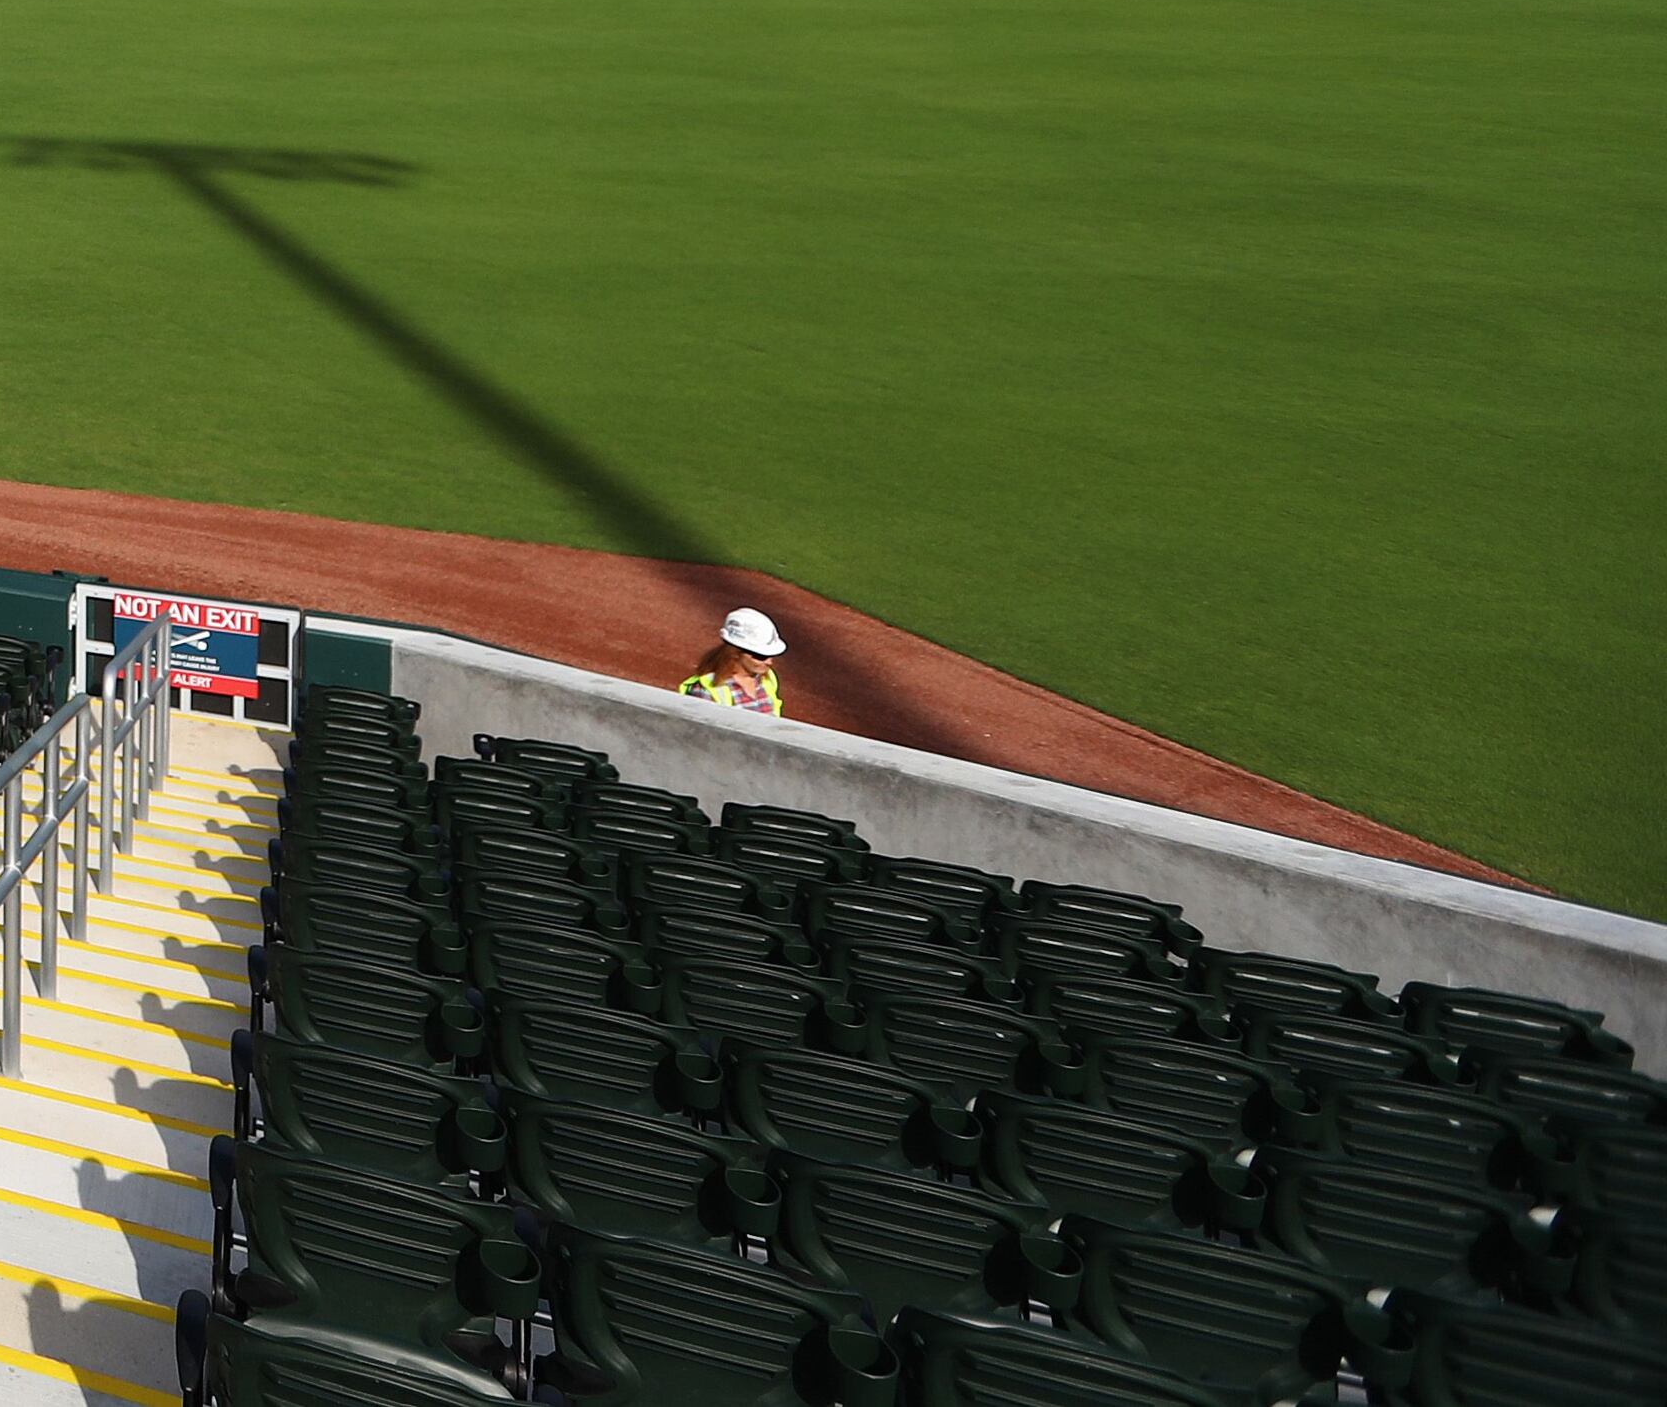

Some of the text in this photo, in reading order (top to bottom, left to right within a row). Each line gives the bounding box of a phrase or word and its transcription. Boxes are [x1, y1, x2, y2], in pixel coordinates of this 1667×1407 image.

[115, 595, 258, 632] NOT AN EXIT
[173, 673, 213, 688] ALERT
